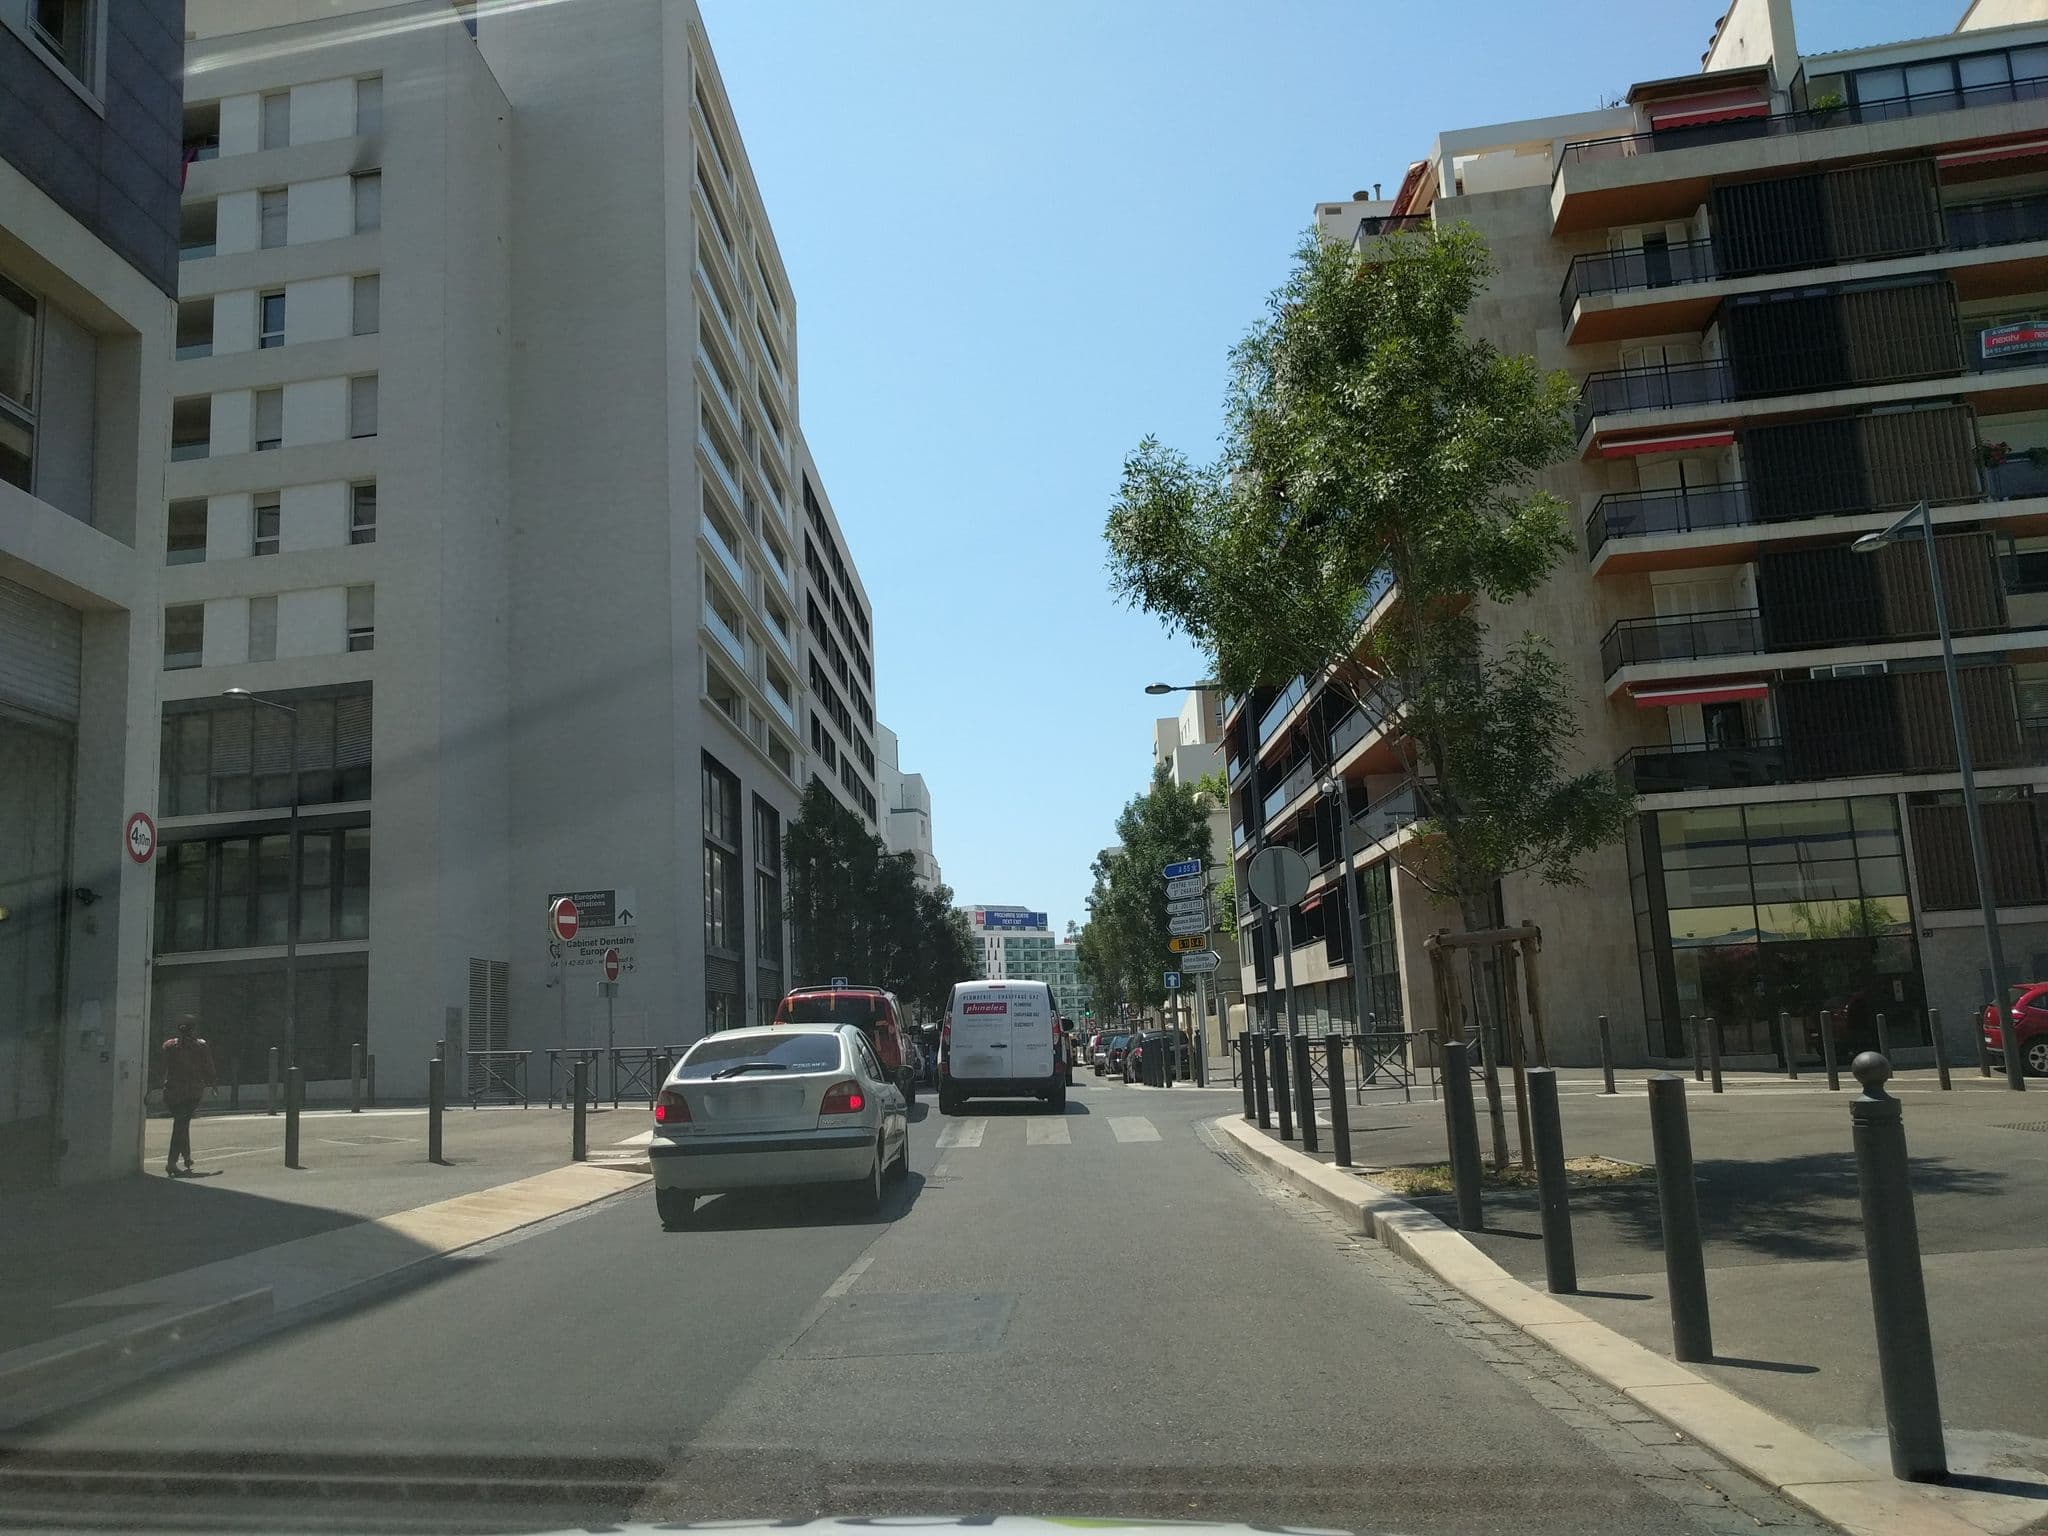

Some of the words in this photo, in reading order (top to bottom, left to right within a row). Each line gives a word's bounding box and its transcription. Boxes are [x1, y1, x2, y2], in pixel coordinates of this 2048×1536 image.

[1991, 334, 2020, 345] nexity
[566, 939, 598, 948] Cabinet
[600, 936, 635, 946] Dentaire
[580, 947, 620, 956] Europn
